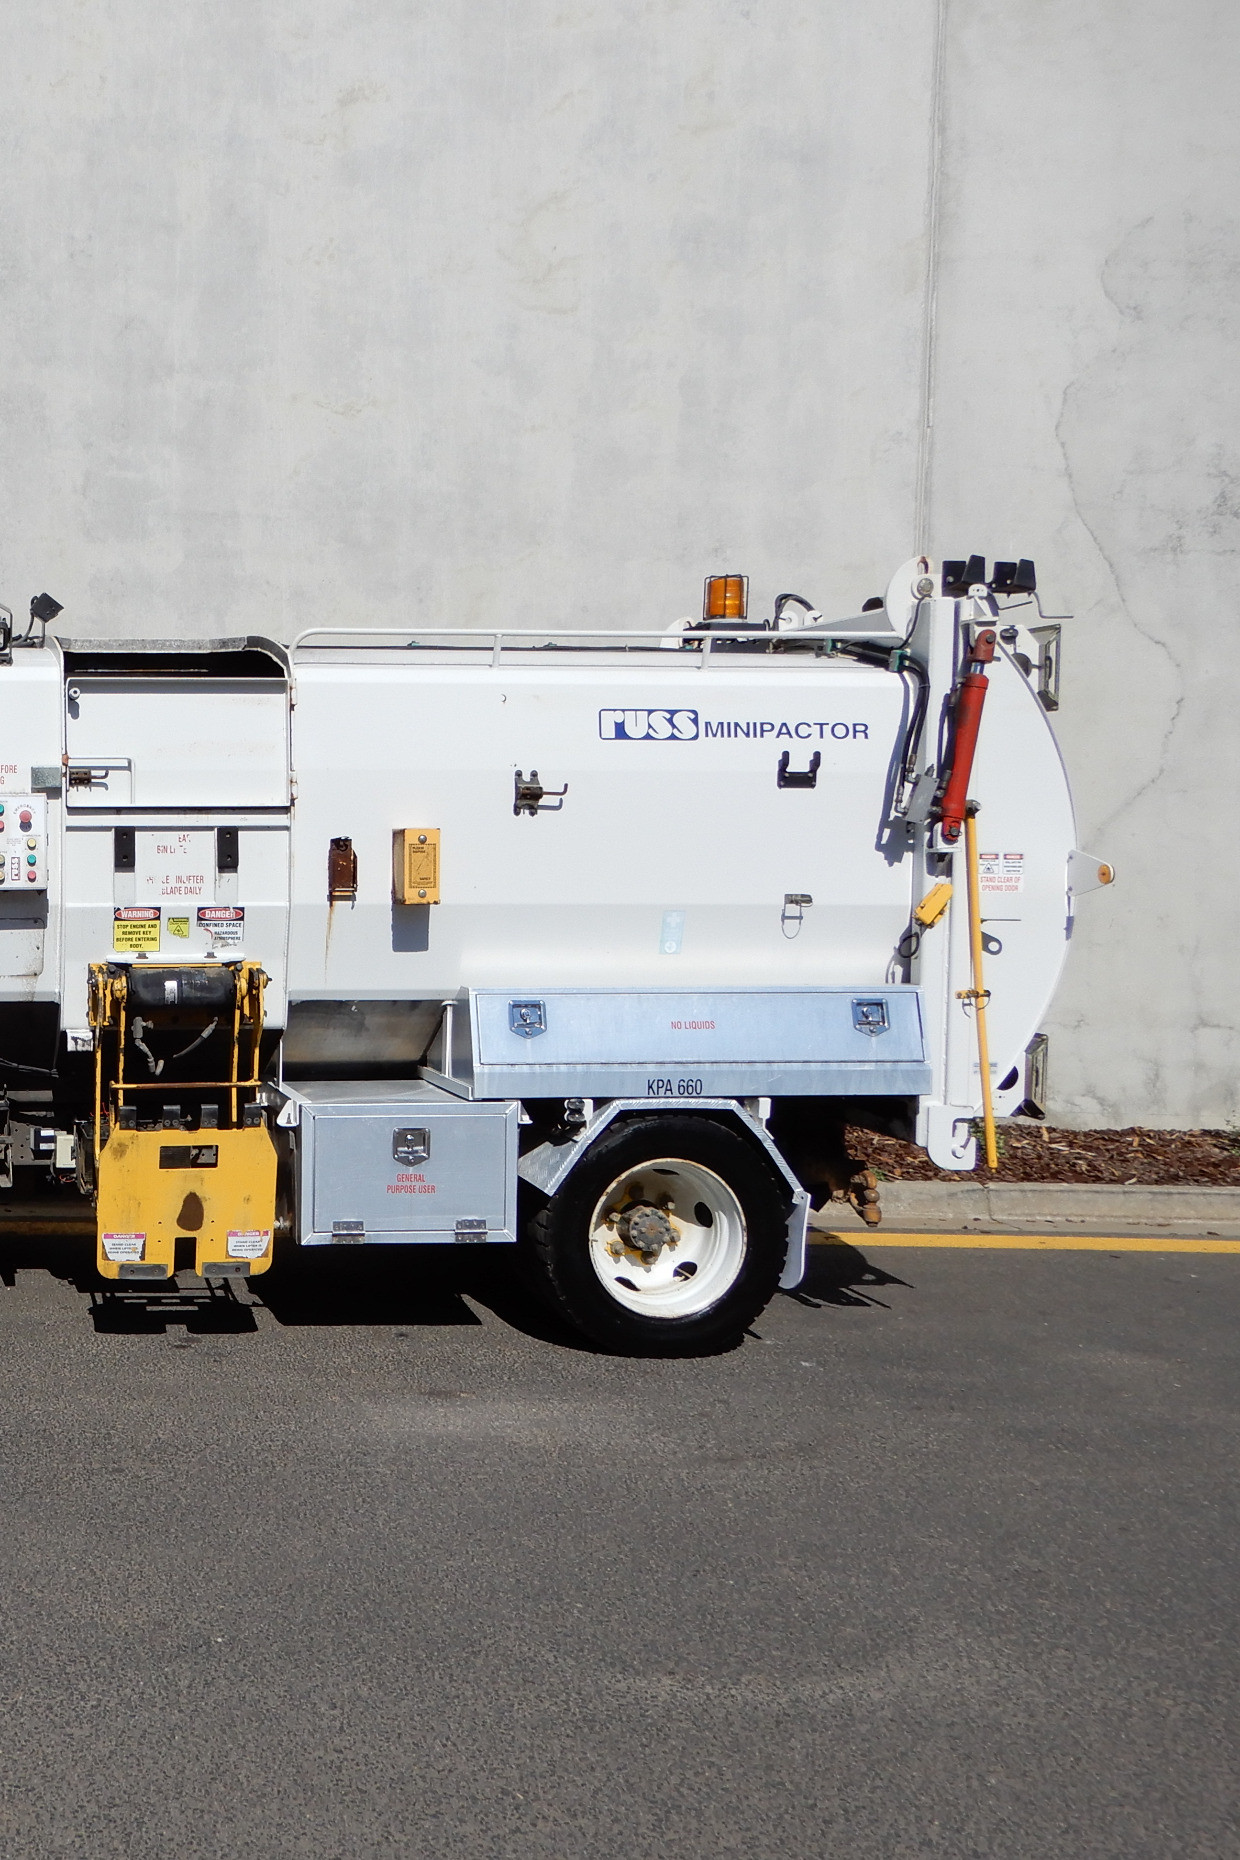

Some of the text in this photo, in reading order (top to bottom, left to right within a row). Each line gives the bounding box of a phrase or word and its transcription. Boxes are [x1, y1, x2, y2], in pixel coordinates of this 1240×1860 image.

[704, 721, 869, 740] MINIPACTOR
[184, 886, 202, 895] DAILY
[121, 910, 154, 918] WARNING
[205, 910, 236, 918] DANGER
[671, 1020, 716, 1030] NO LIQUIDS
[647, 1079, 703, 1095] KPA 660
[396, 1174, 426, 1182] GENERAL
[386, 1185, 436, 1193] PURPOSE USER
